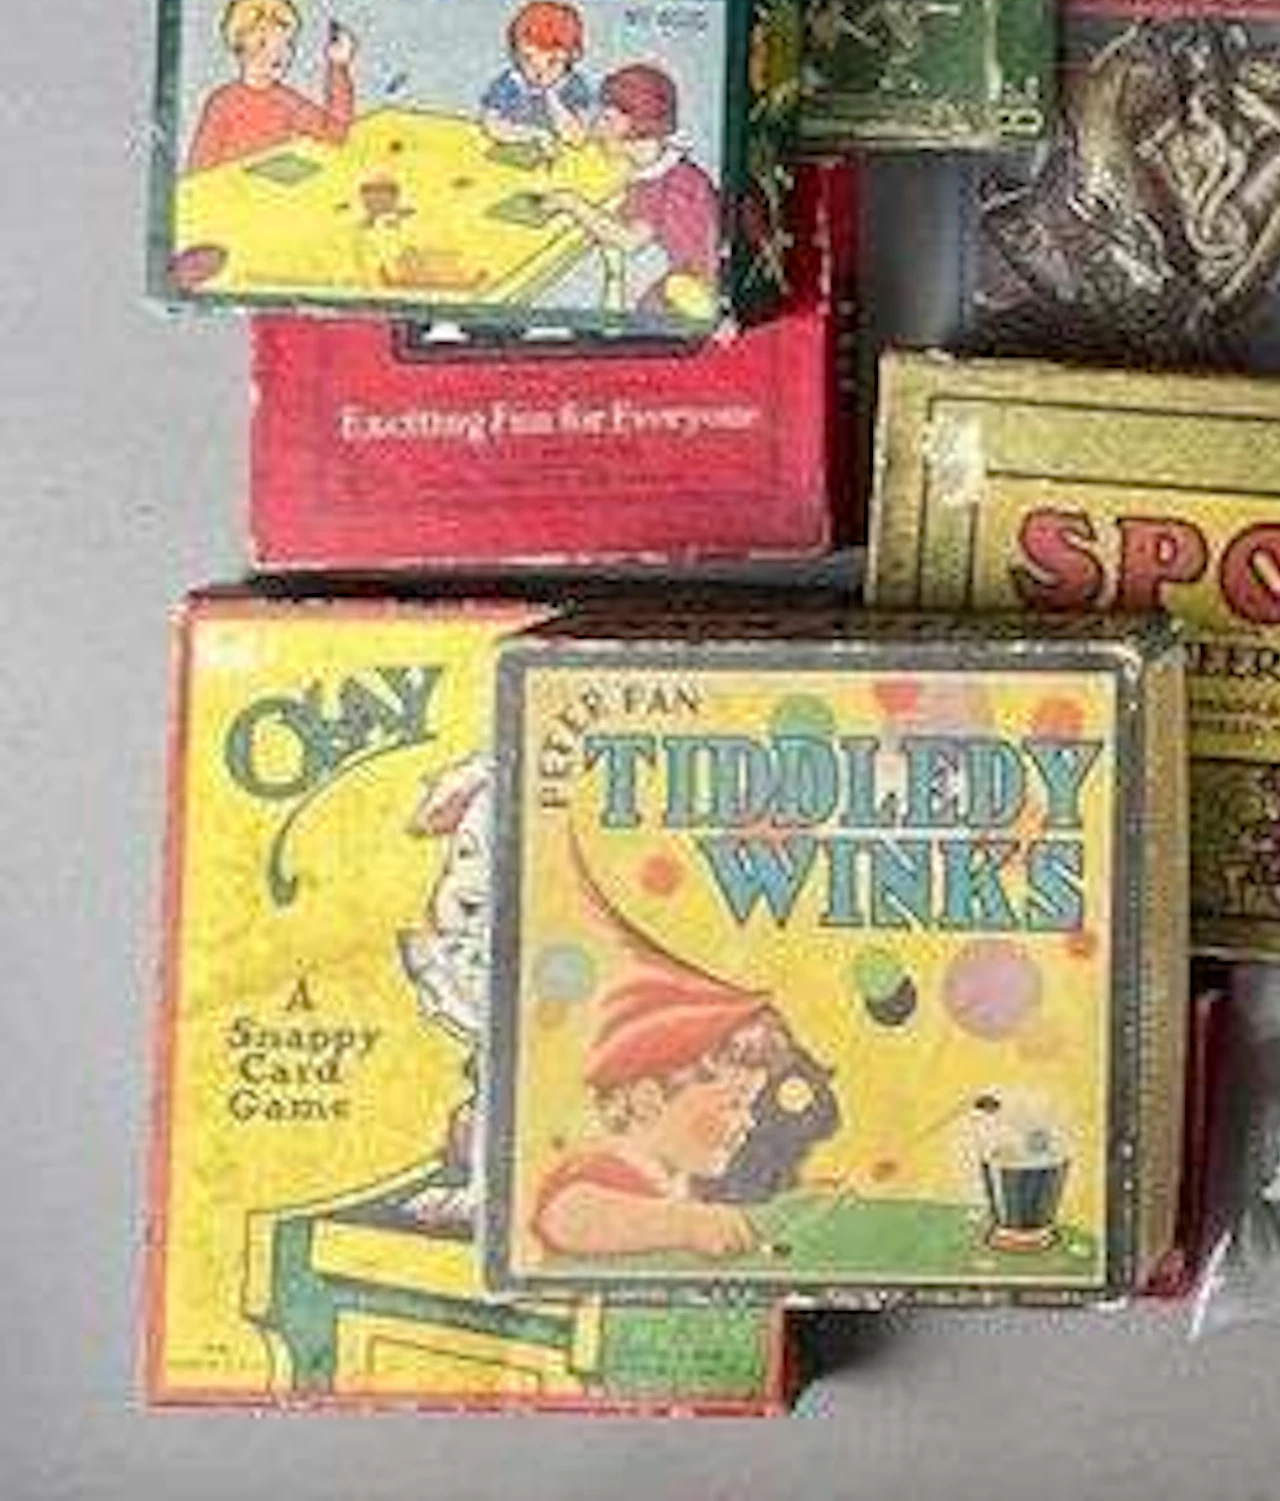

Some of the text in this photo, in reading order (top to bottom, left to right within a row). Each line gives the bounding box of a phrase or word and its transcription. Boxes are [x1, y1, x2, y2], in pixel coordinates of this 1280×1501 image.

[340, 400, 762, 444] Exciting Fun for Everyone
[622, 682, 702, 717] PAN
[584, 734, 1104, 830] TIDDLEDY
[695, 834, 1085, 932] WINKS
[285, 974, 314, 1013] A
[226, 1019, 381, 1056] Snappy
[240, 1054, 341, 1088] Card
[228, 1089, 354, 1124] Game
